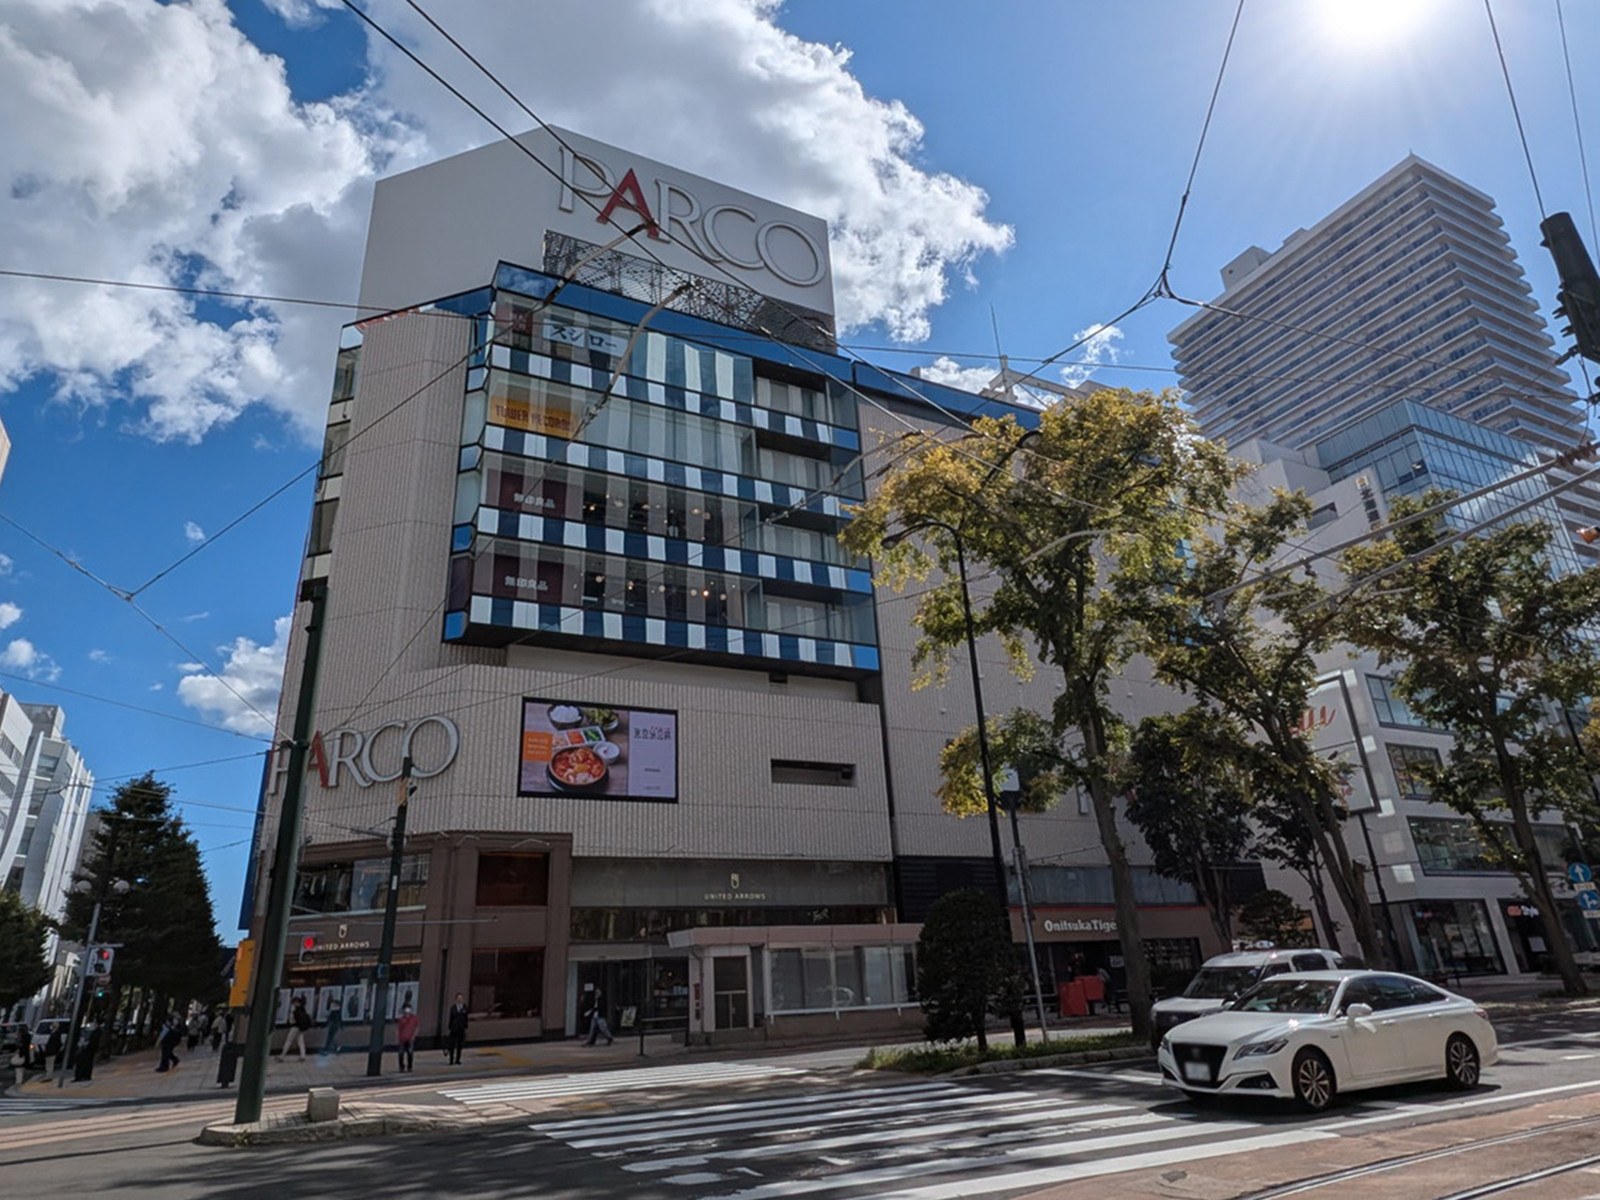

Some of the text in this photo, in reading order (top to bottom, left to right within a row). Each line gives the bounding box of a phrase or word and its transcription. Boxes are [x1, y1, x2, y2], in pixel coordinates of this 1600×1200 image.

[559, 147, 827, 287] PARCO
[549, 324, 618, 348] スシロー
[340, 941, 370, 949] ARROWS
